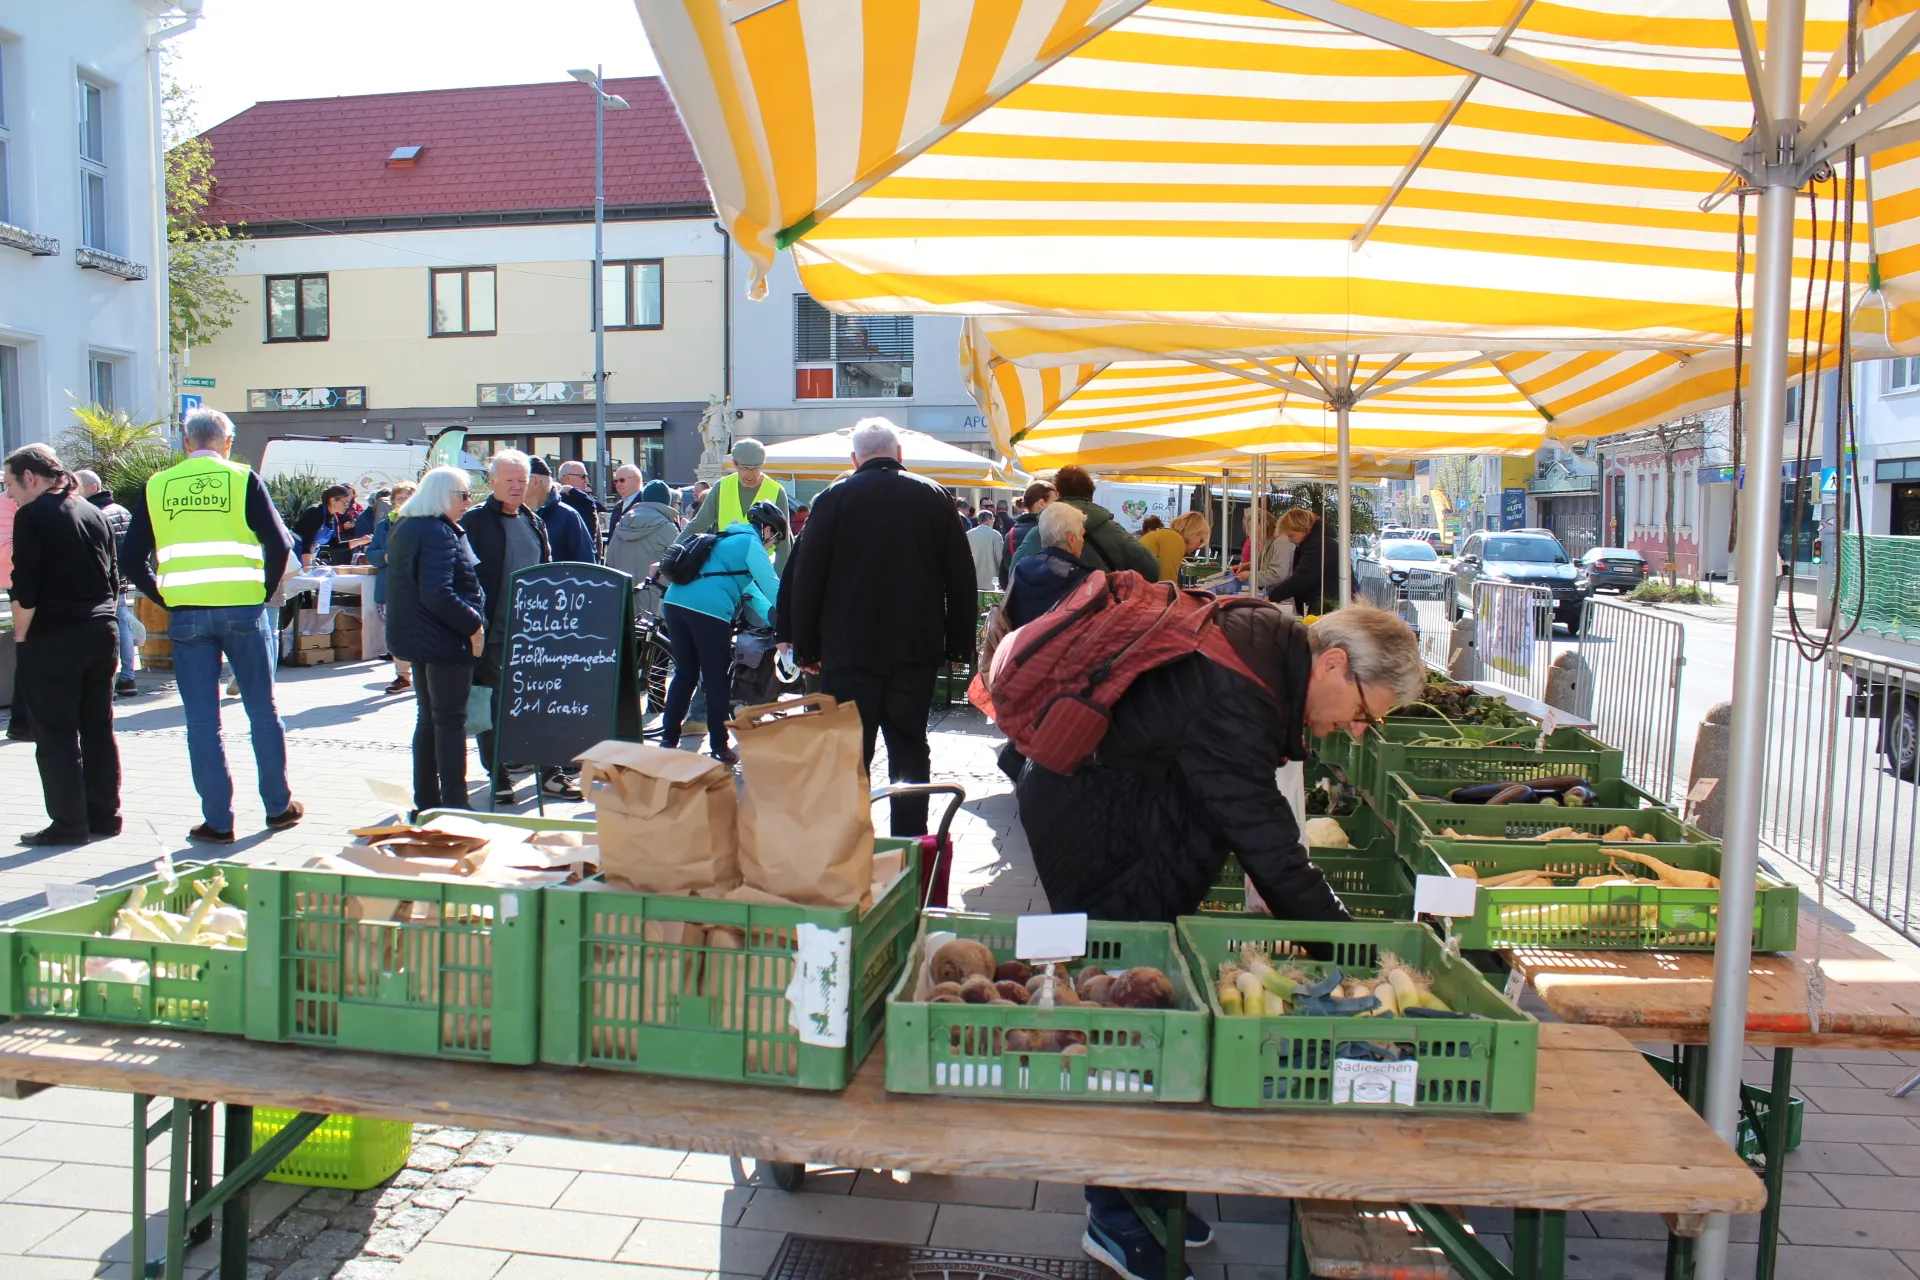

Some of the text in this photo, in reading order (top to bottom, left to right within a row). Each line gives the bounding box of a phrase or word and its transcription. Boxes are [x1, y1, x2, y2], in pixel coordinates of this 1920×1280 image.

[281, 388, 331, 405] BAR
[513, 382, 566, 401] BAR
[166, 494, 227, 508] radlobby
[514, 587, 549, 619] frische
[523, 612, 579, 633] Salate
[509, 644, 617, 672] Eröffnungsangebot
[512, 671, 562, 694] Sirupe
[509, 697, 589, 717] 2+1 Gratis
[1335, 1061, 1412, 1073] Radieschen
